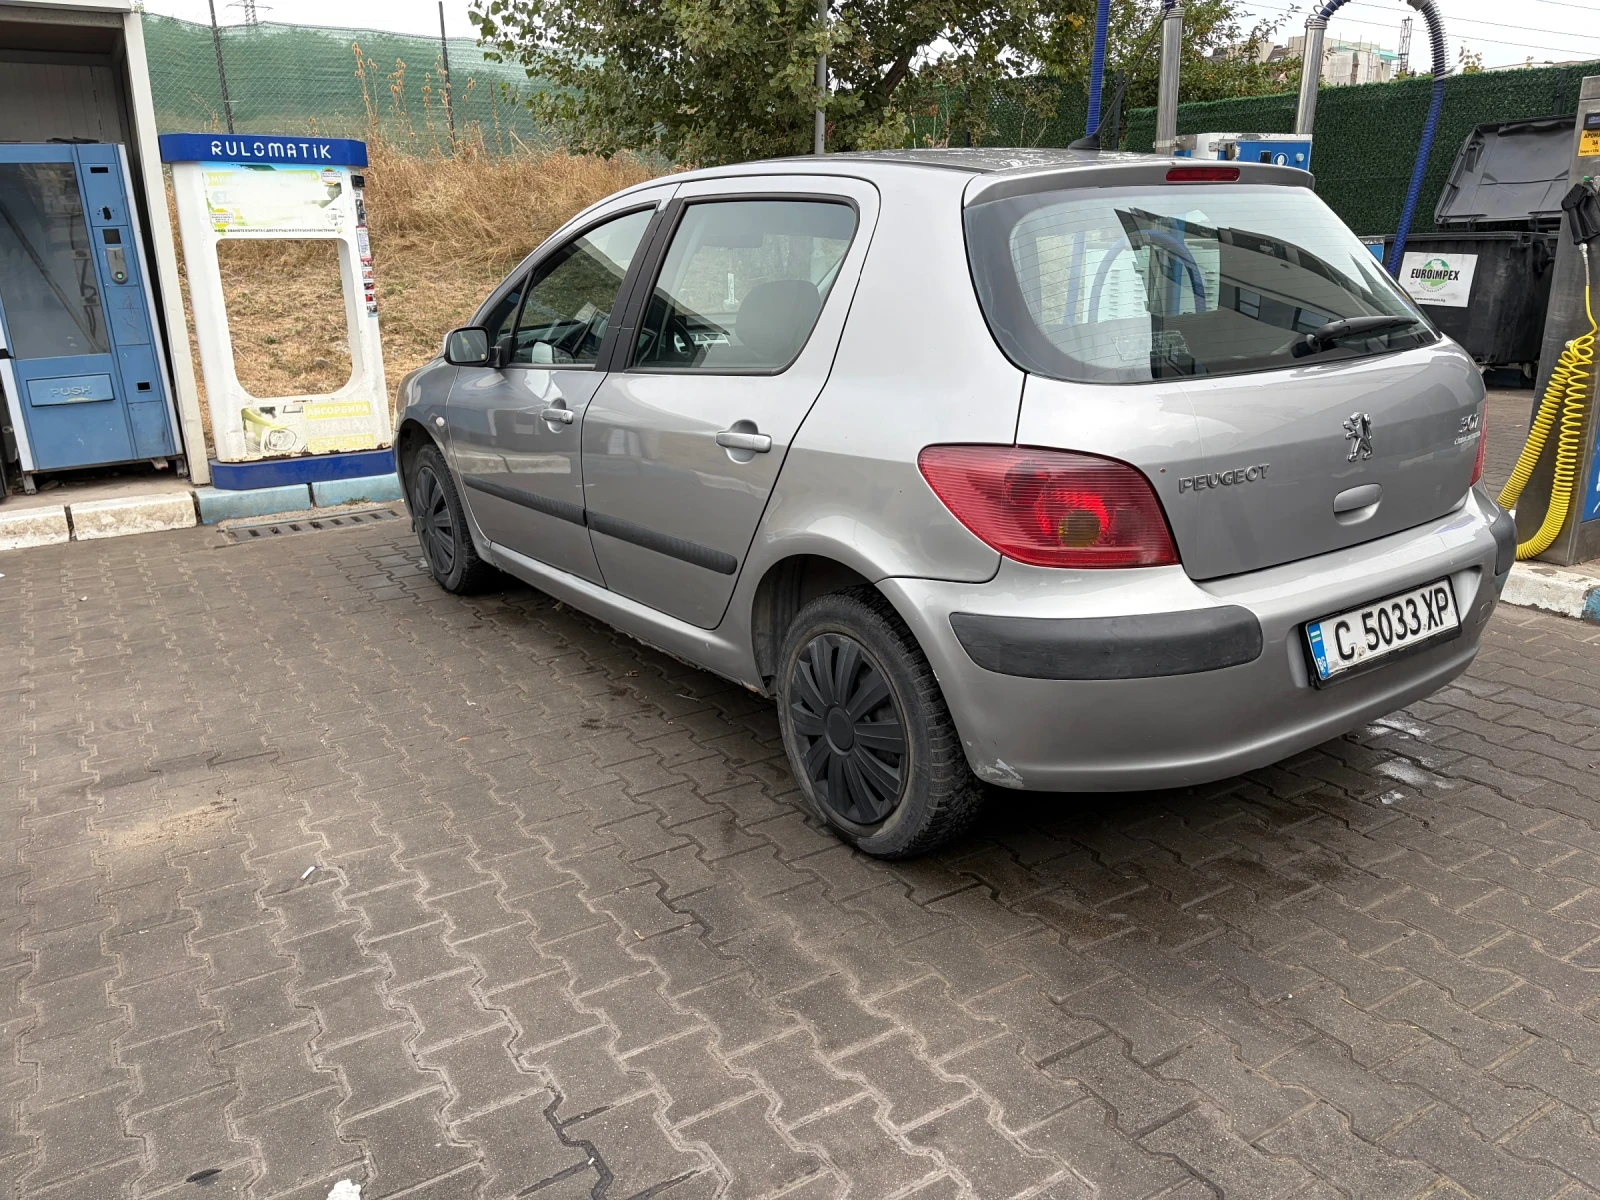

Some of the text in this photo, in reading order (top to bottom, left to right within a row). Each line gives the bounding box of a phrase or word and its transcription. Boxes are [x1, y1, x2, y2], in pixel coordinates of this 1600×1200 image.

[211, 140, 332, 159] RULOMATIK
[1410, 268, 1460, 281] EUROIMPEX
[50, 386, 92, 397] PUSH
[307, 404, 369, 416] АБСОРБИРА
[1178, 463, 1270, 494] PEUGEOT
[1361, 598, 1422, 651] 5033
